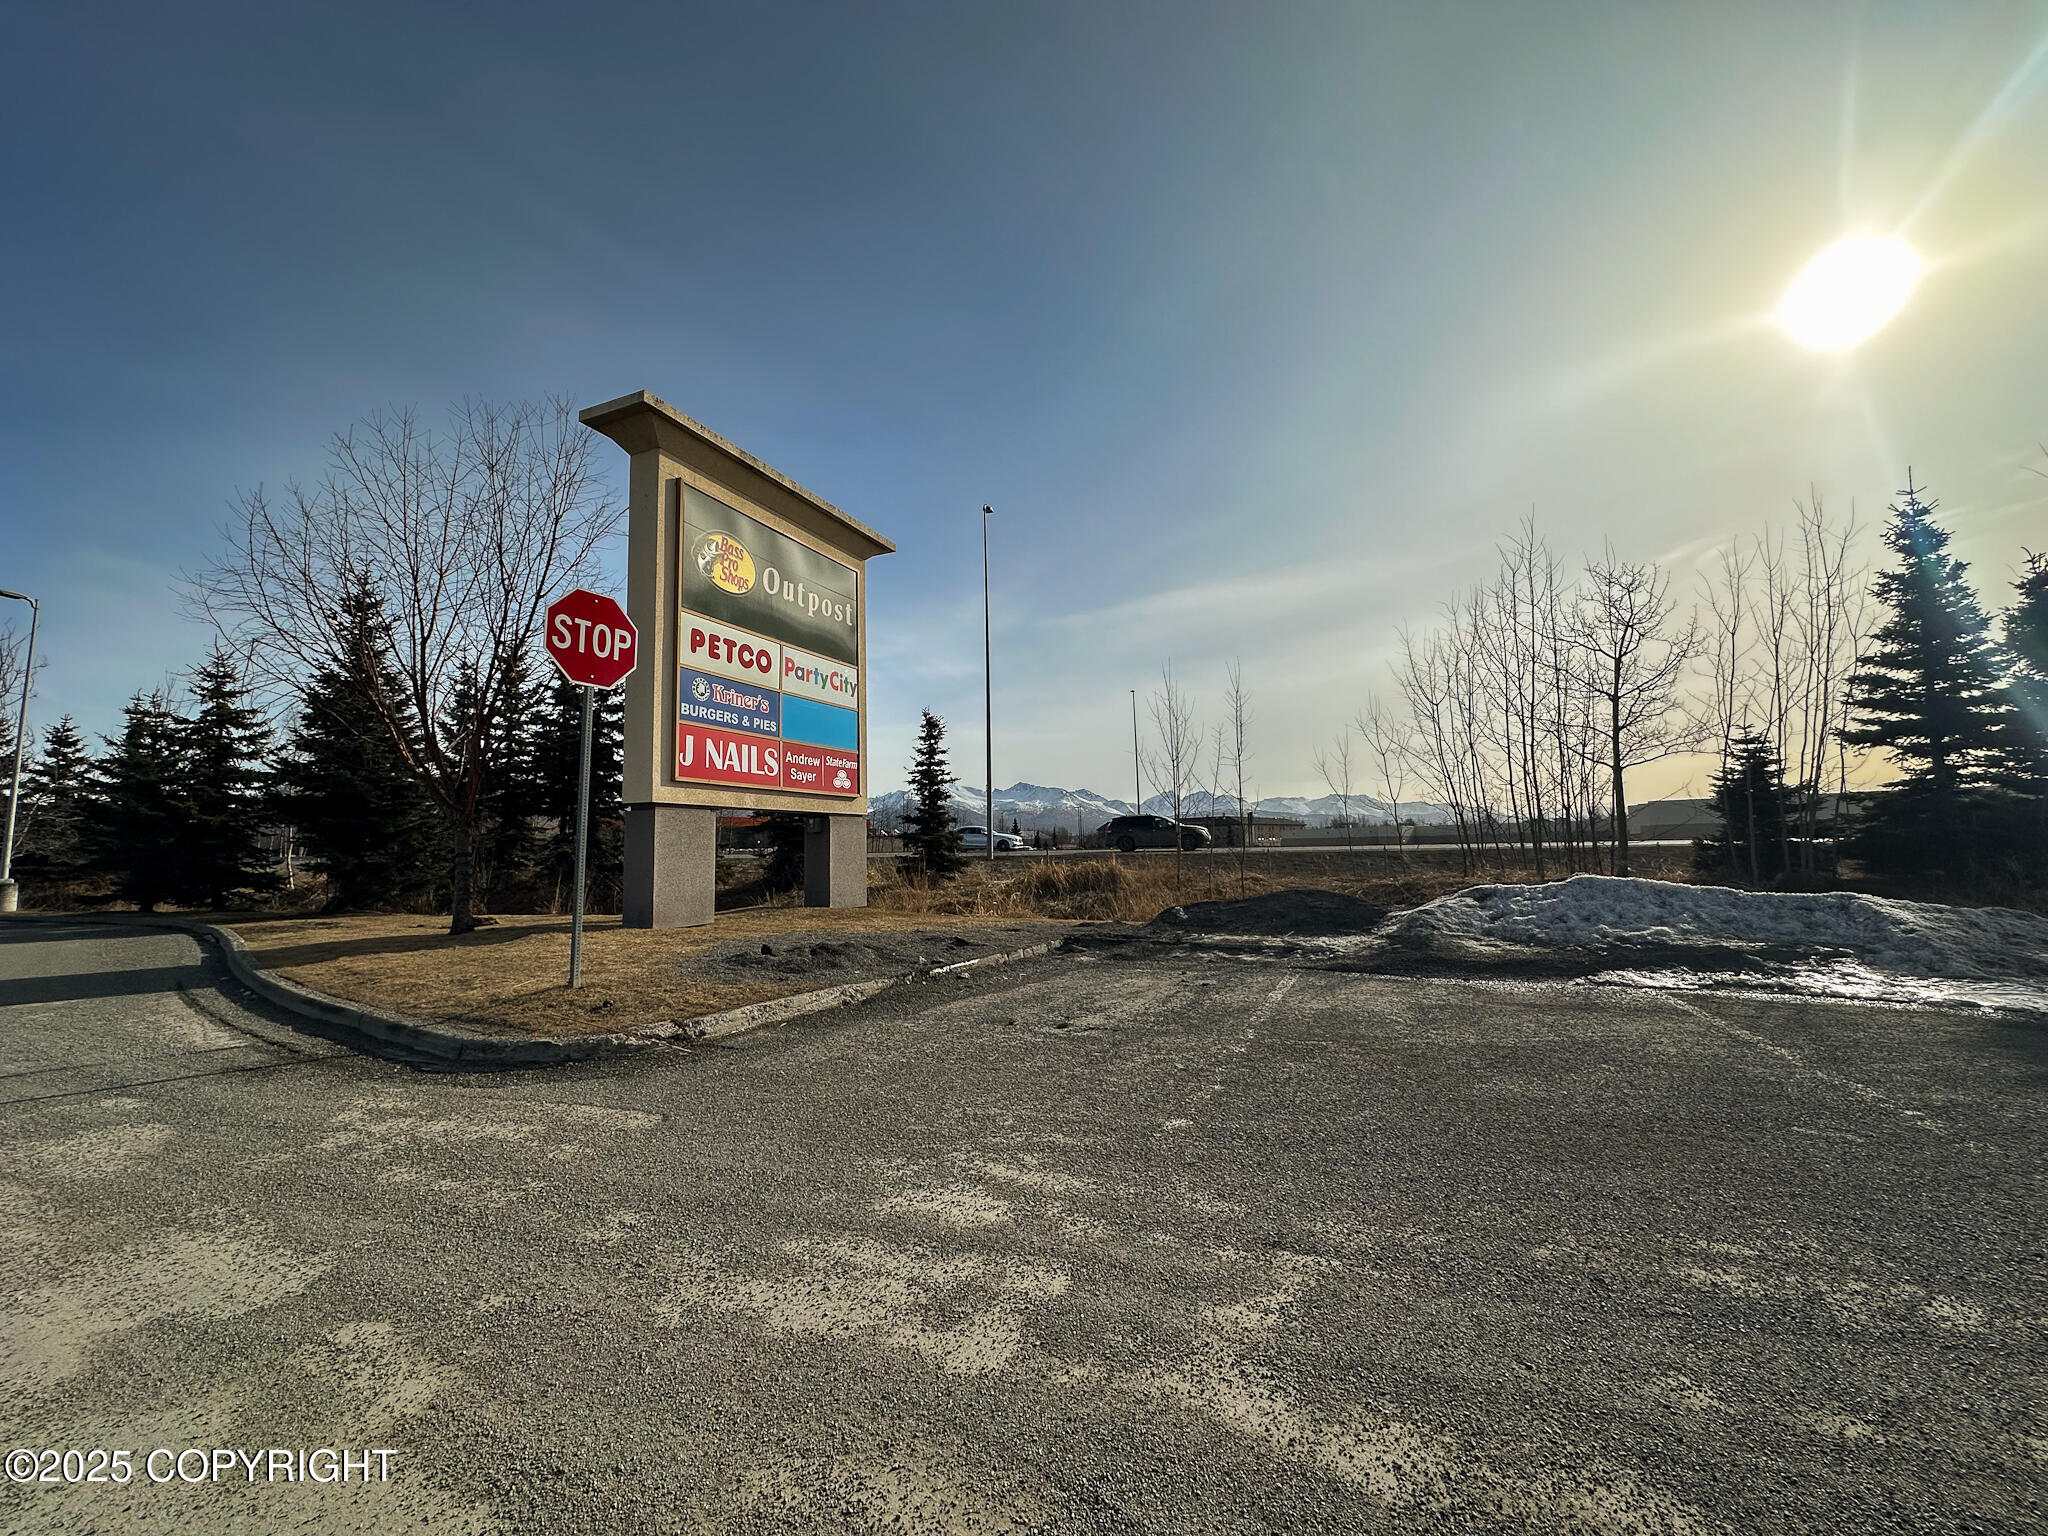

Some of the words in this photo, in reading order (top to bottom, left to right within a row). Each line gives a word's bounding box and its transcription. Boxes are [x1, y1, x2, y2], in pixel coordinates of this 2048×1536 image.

[720, 536, 744, 561] Bass
[720, 553, 739, 572] Pro
[720, 566, 750, 591] Shops
[763, 567, 853, 626] Outpost
[551, 614, 632, 661] STOP
[690, 628, 772, 674] PETCO
[712, 684, 770, 713] Kriner's
[680, 702, 739, 725] BURGERS
[742, 715, 750, 727] &
[753, 717, 777, 732] PIES
[679, 735, 694, 766] J
[705, 738, 779, 776] NAILS
[785, 751, 820, 767] Andrew
[790, 767, 816, 784] Sayer
